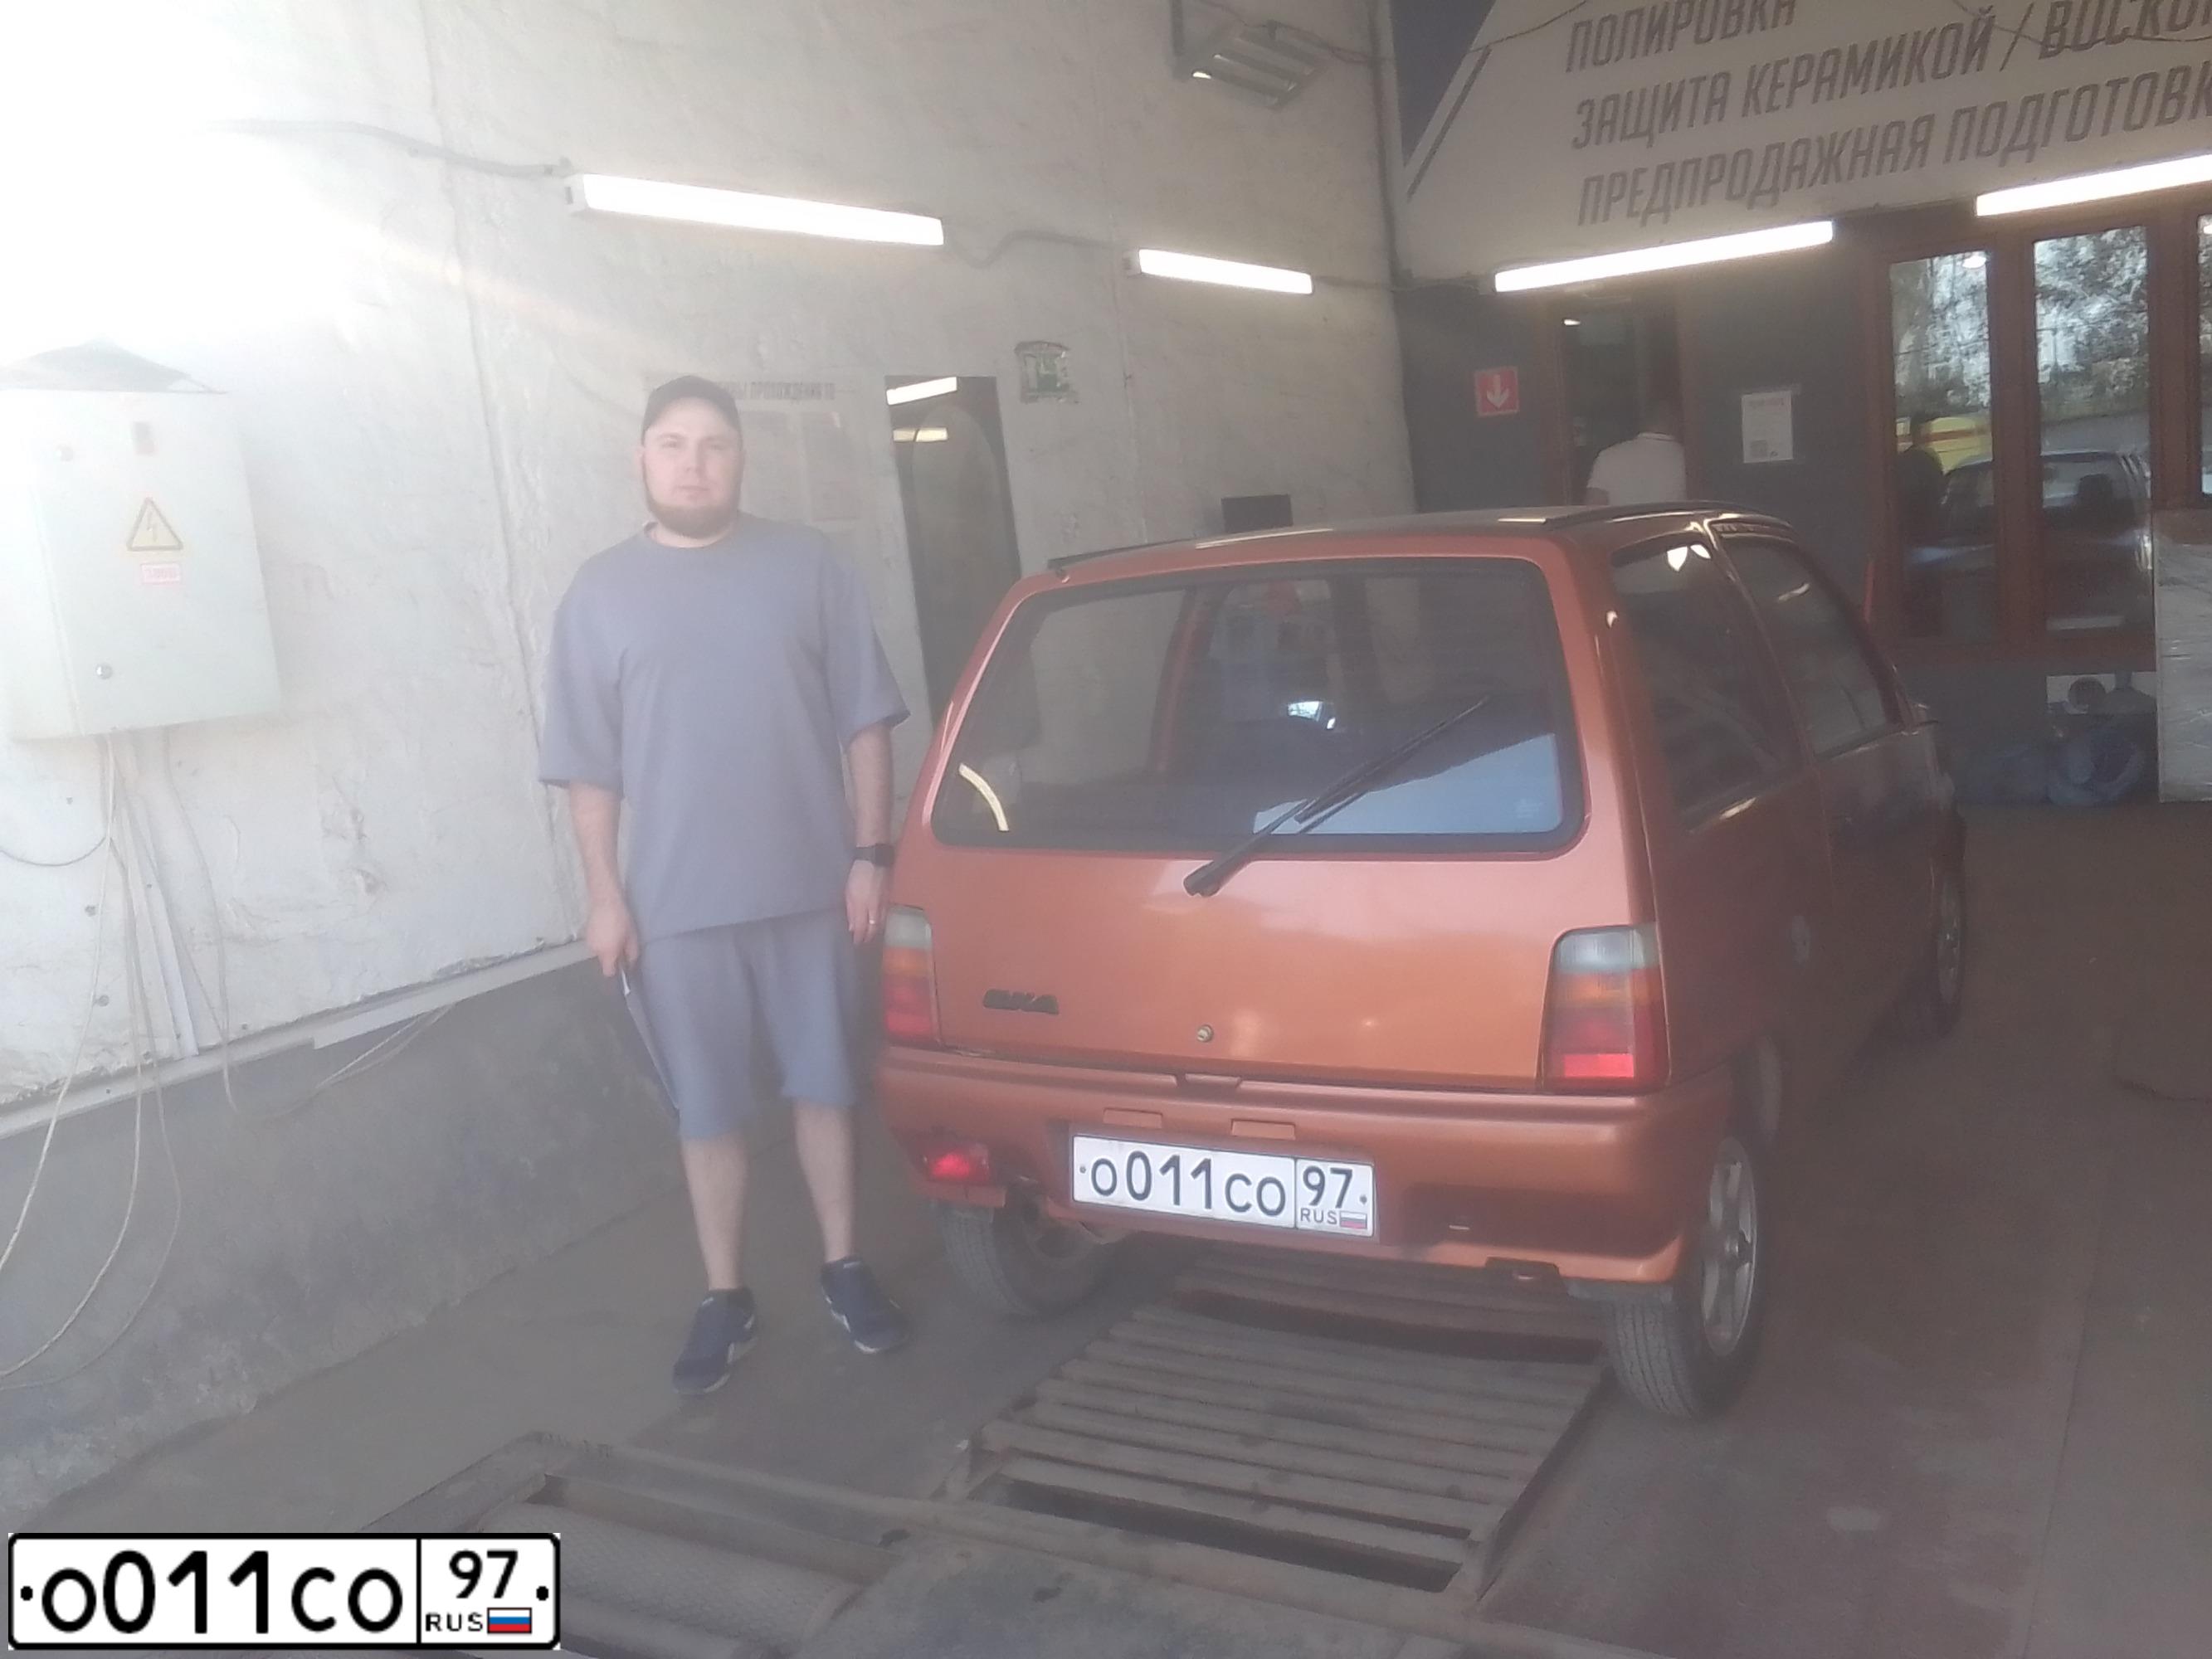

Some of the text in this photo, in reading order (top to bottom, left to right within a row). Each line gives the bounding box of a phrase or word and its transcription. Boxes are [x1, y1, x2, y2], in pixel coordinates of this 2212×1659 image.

[1571, 71, 1732, 150] ЗАЩИТА
[1742, 5, 1995, 118] КЕРАМИКОЙ
[2038, 0, 2212, 60] ВОСКО
[1578, 114, 1935, 228] ПРЕДПРОДАЖНАЯ
[1300, 1209, 1337, 1225] RUS
[1303, 1165, 1352, 1209] 97
